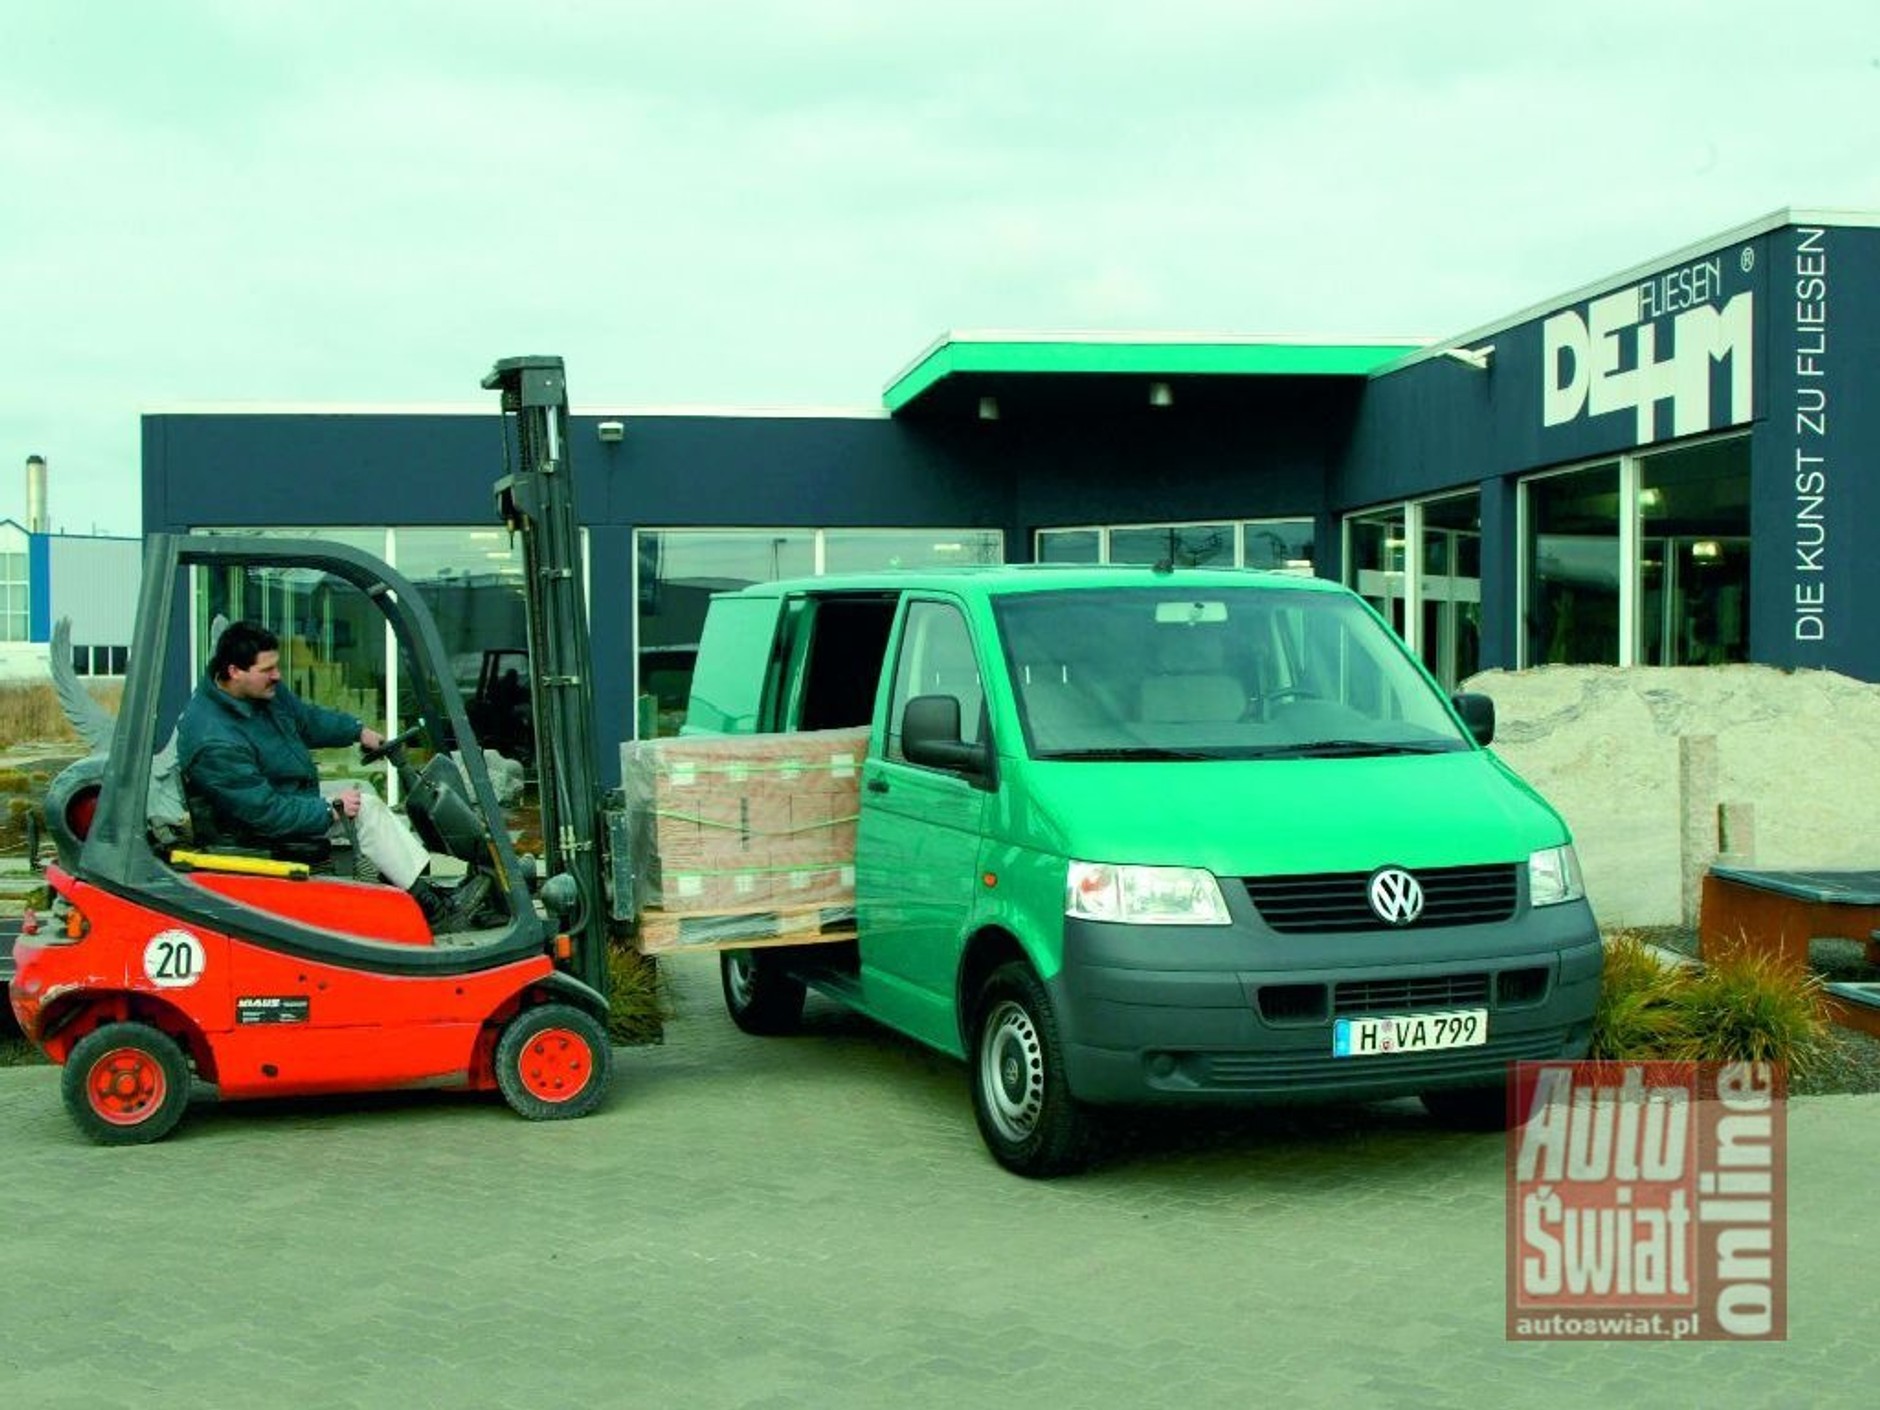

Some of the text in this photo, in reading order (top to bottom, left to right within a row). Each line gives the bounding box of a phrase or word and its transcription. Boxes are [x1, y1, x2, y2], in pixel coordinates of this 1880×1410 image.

[1640, 257, 1721, 320] FLIESEN
[1543, 285, 1753, 445] DEHM
[1796, 228, 1826, 641] DIE KUNST ZU FLIESEN
[157, 942, 192, 978] 20
[1361, 1025, 1377, 1050] H
